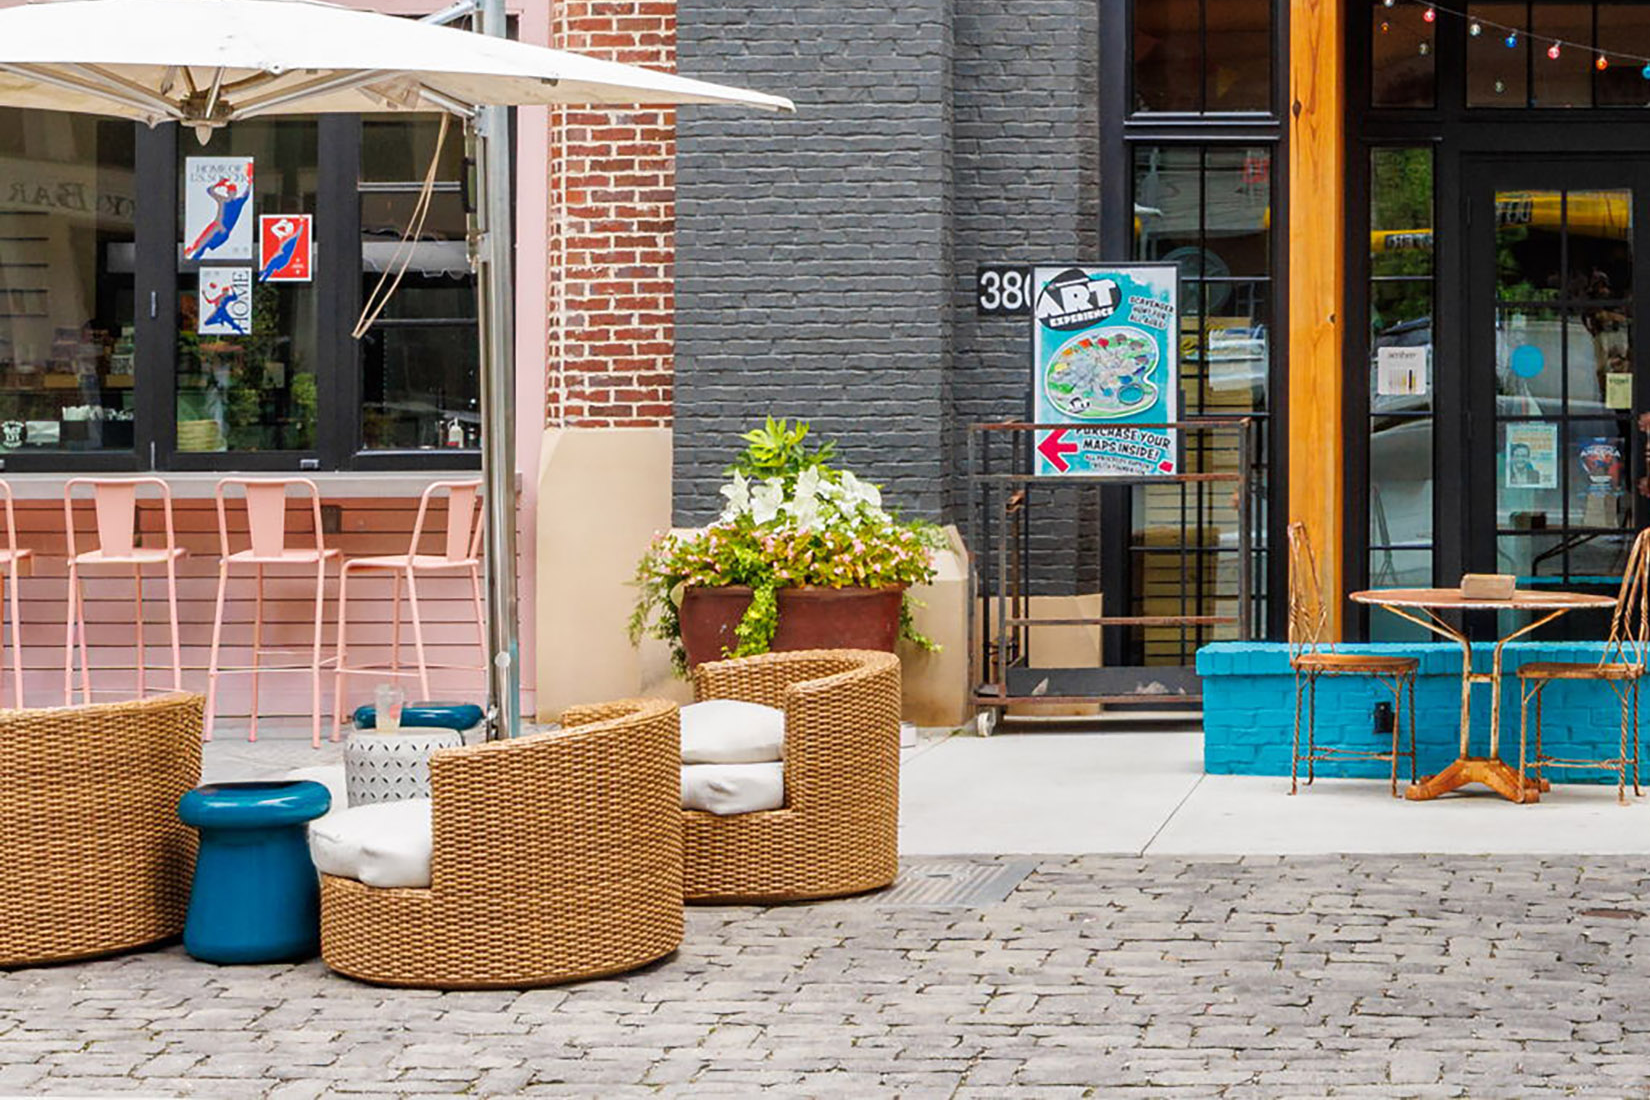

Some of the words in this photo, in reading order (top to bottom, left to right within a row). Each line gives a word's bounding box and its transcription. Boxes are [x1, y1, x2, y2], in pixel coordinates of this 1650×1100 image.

[1036, 278, 1117, 320] ART
[1050, 307, 1114, 328] EXPERIENCE
[1083, 439, 1116, 451] MAPS
[1118, 443, 1159, 460] INSIDE!
[1141, 432, 1171, 449] YOUR
